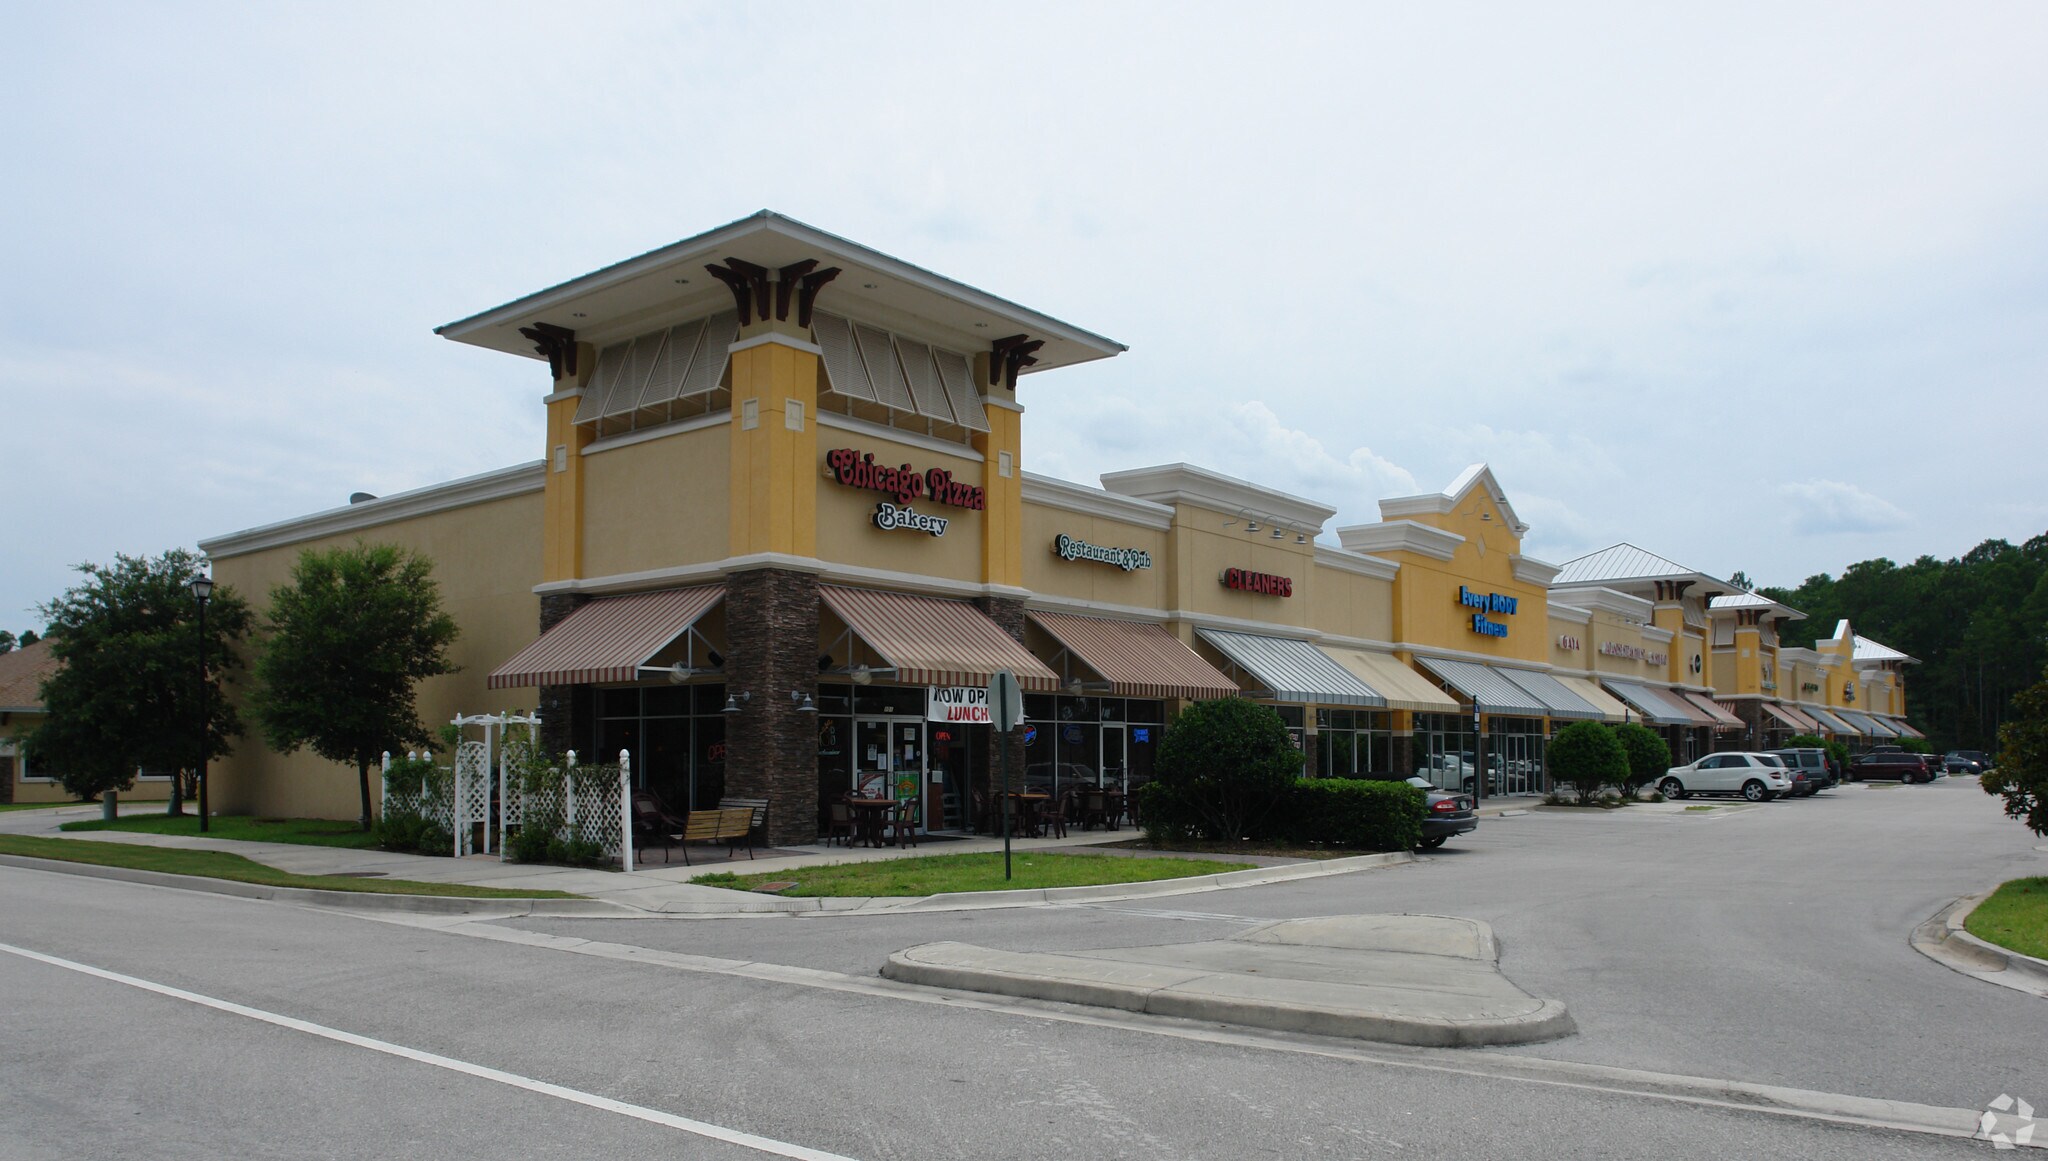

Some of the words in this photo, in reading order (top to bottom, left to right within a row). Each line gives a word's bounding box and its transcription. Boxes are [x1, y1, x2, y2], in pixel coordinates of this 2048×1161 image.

[829, 448, 923, 504] Chicago
[927, 468, 985, 510] Pizza
[876, 503, 948, 537] Bakery
[1059, 534, 1121, 564] Restaurant
[1121, 549, 1131, 571] &
[1131, 549, 1152, 569] Pub
[1226, 567, 1292, 597] CLEANERS
[1460, 585, 1490, 614] Every
[1491, 593, 1518, 615] BODY
[1473, 614, 1507, 638] Fitness
[933, 687, 963, 703] NOW
[947, 706, 988, 721] LUNCH
[935, 731, 951, 741] OPEN
